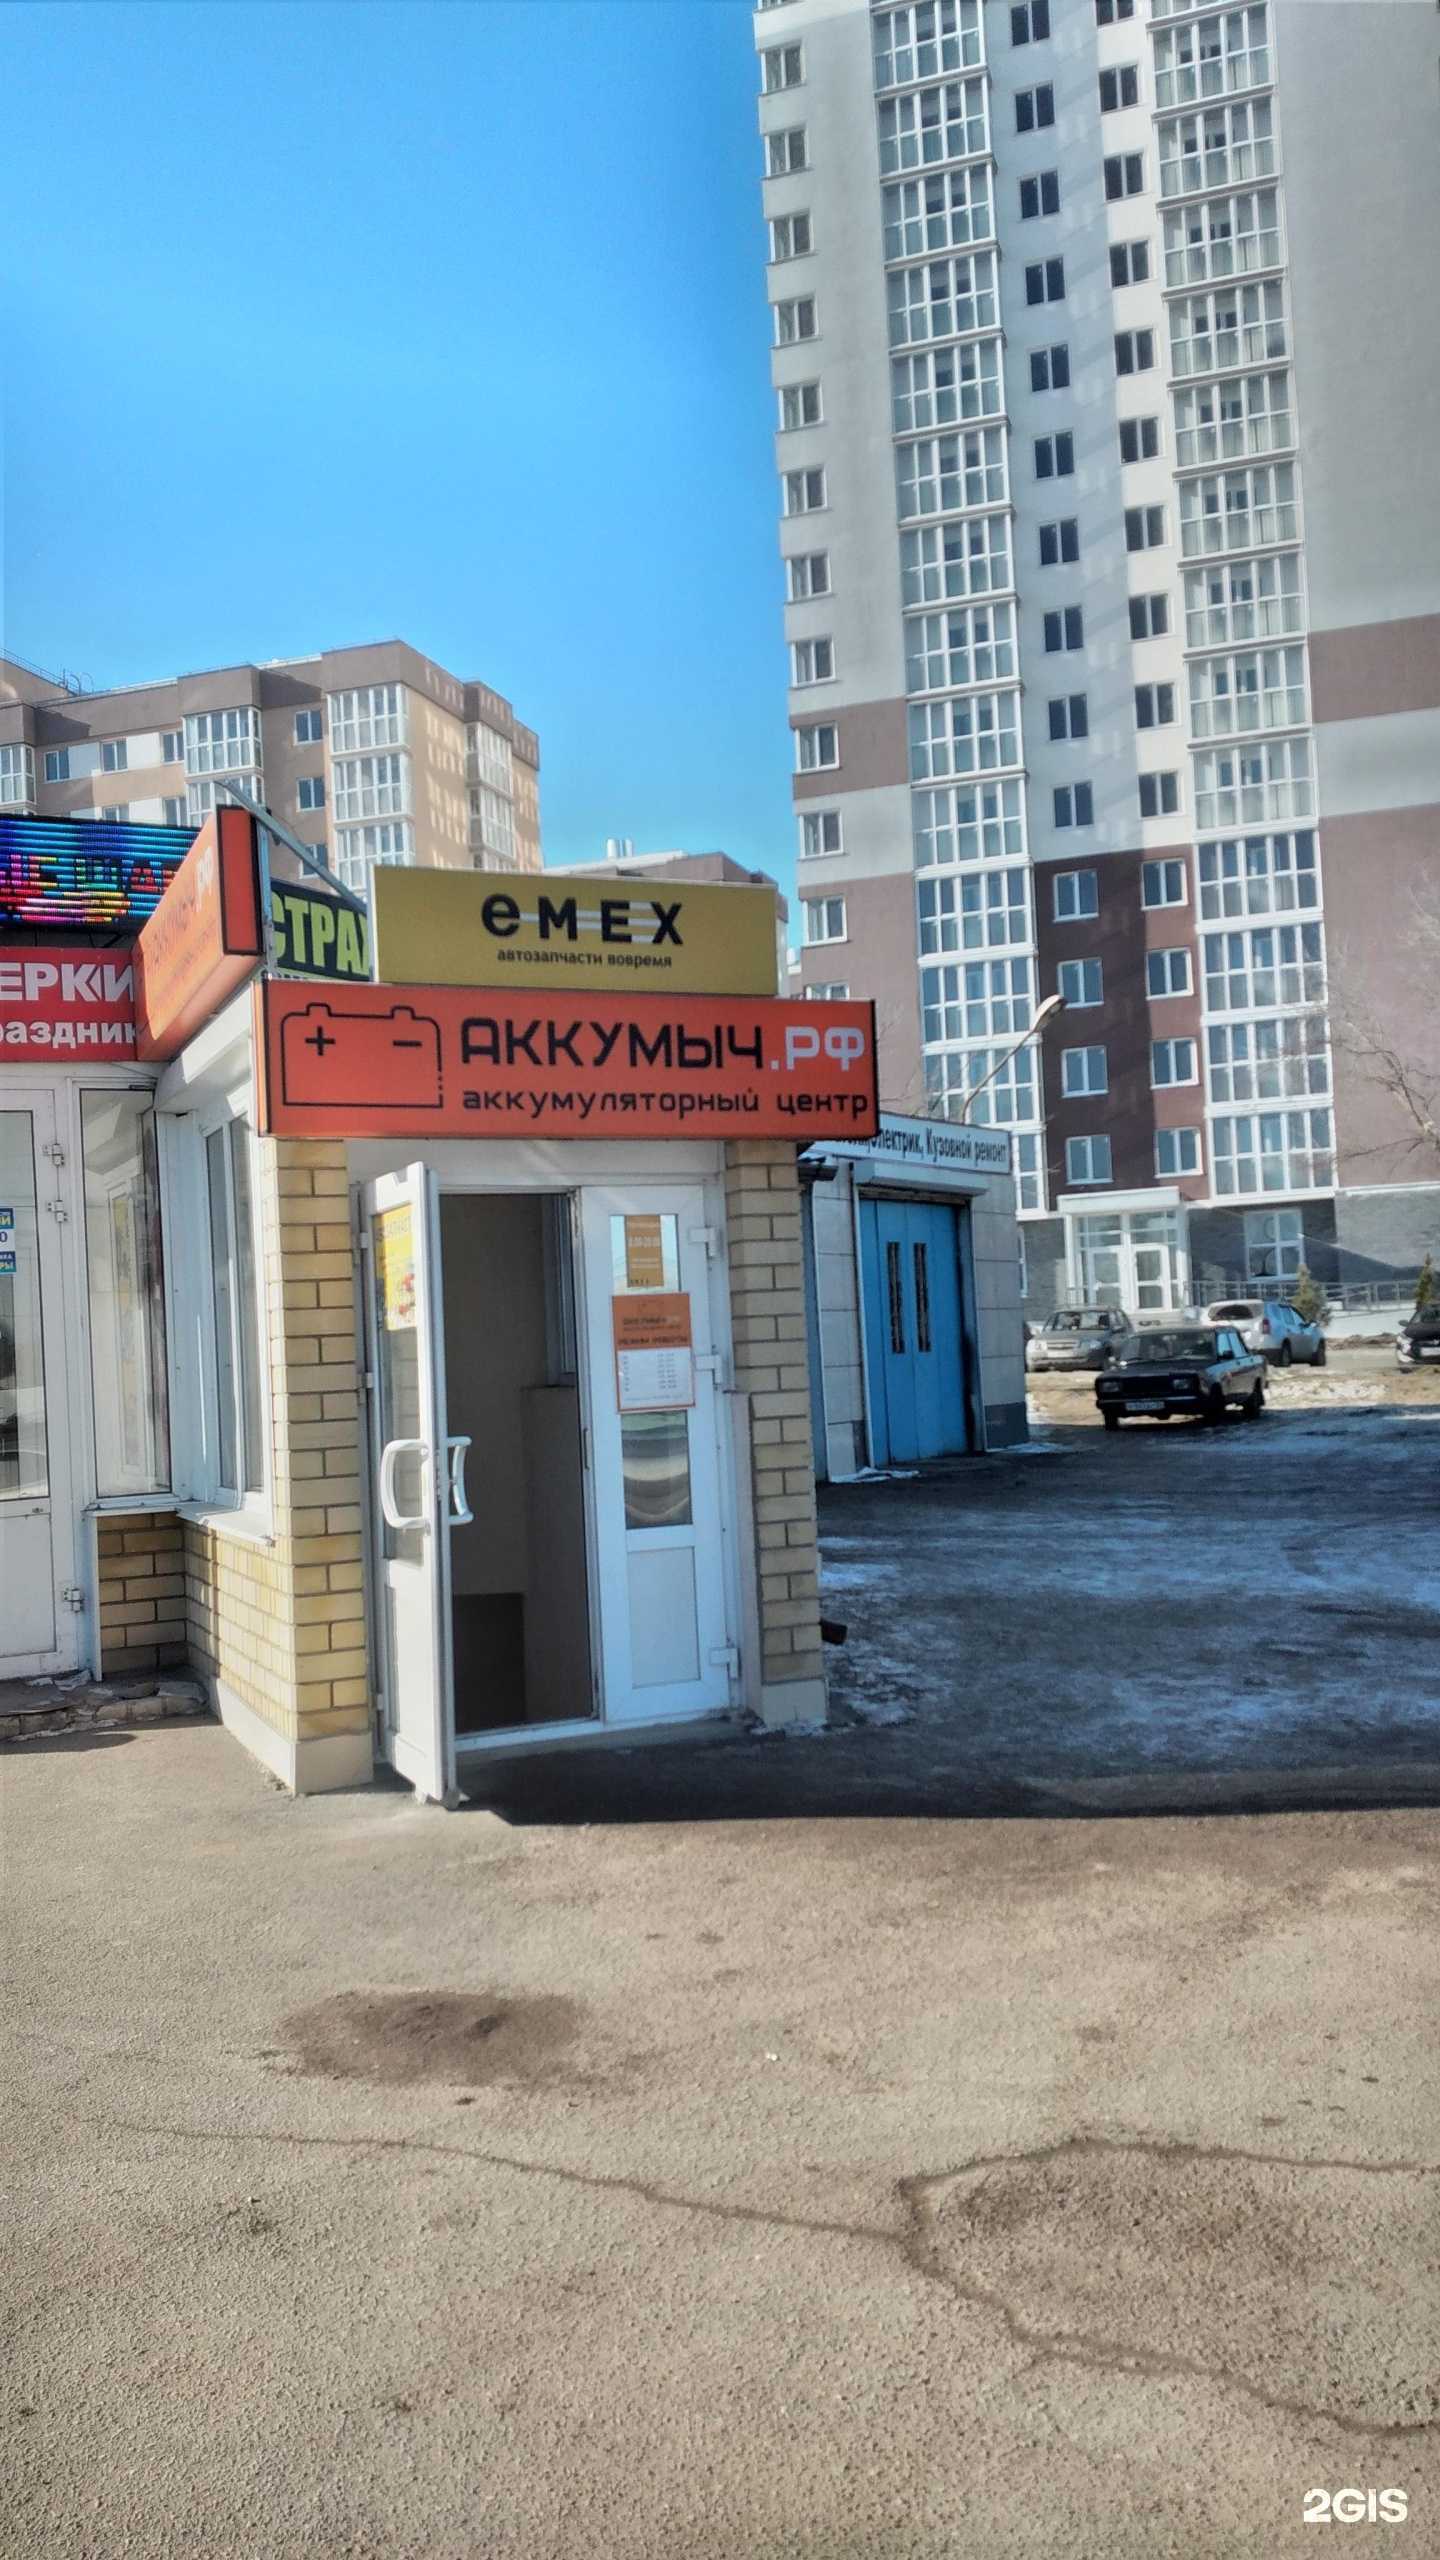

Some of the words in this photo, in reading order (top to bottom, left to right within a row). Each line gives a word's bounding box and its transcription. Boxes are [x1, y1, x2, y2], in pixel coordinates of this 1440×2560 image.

[497, 949, 603, 966] автозапчасти
[607, 953, 672, 969] вовремя
[461, 1017, 866, 1072] АККУМЫЧ.РФ
[463, 1088, 760, 1120] аккумуляторный
[777, 1092, 868, 1120] центр
[926, 1127, 972, 1163] Кузовной
[973, 1139, 1007, 1167] ремонт
